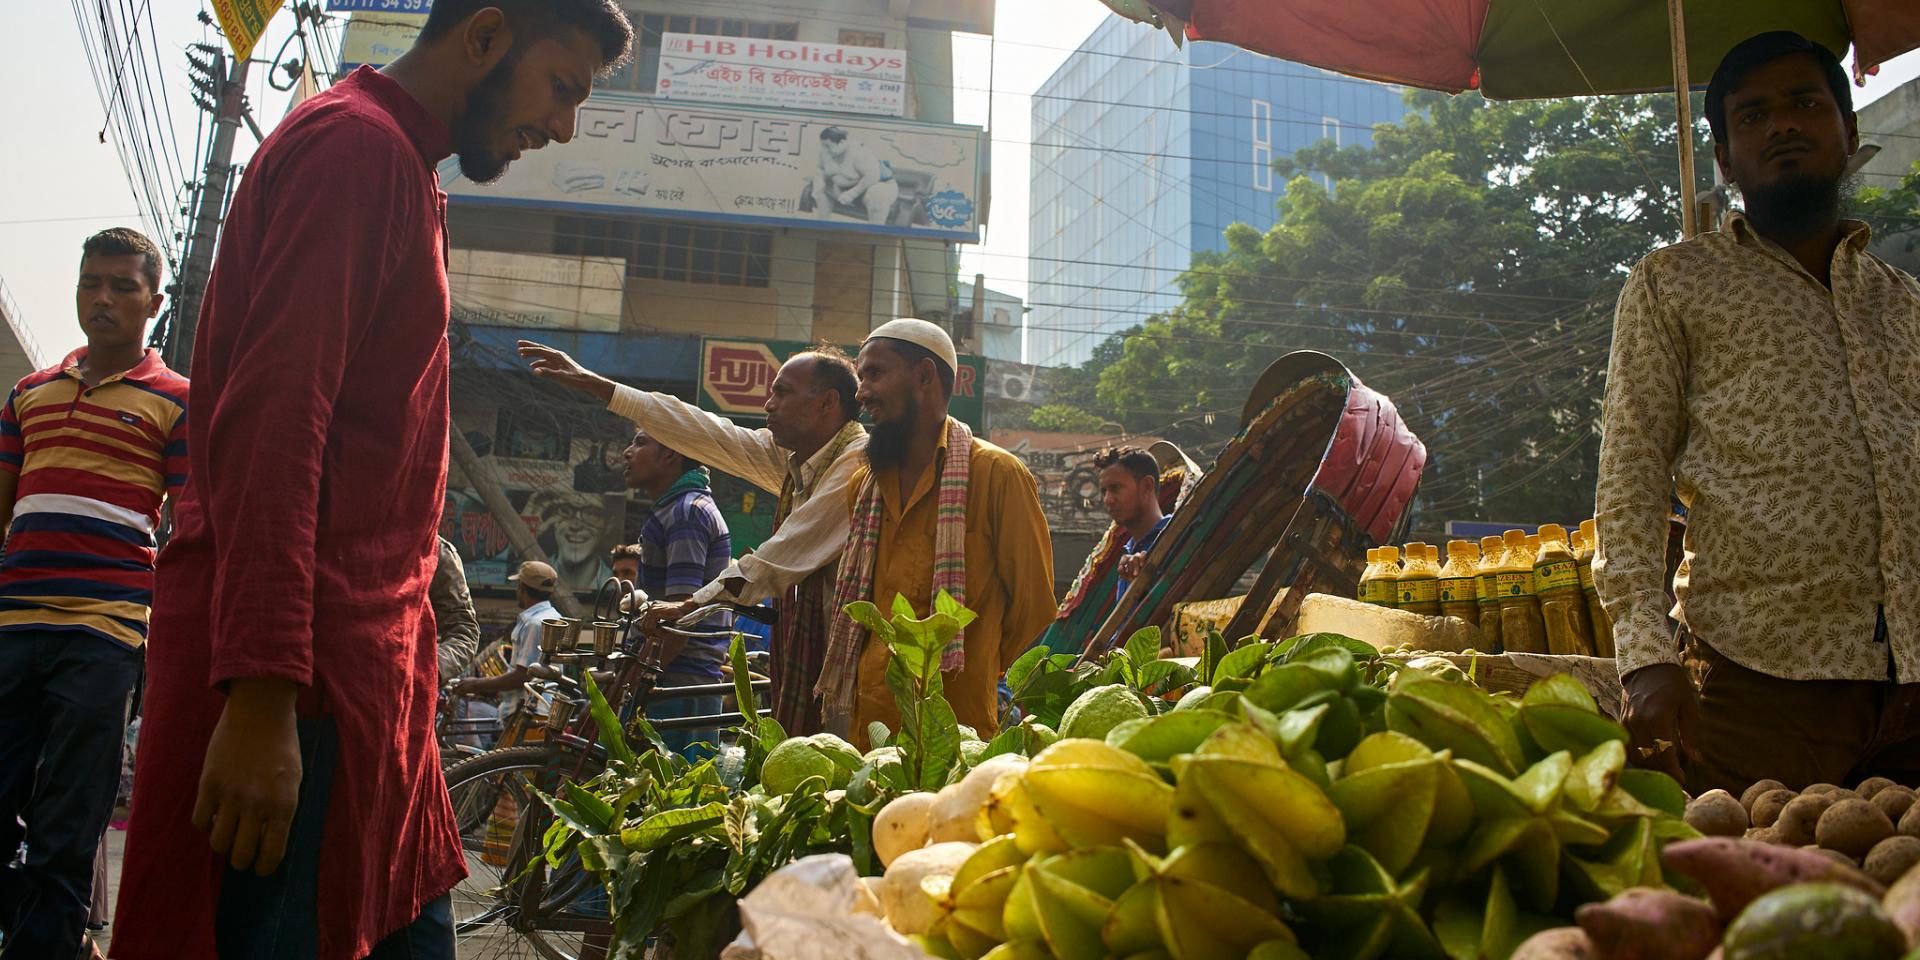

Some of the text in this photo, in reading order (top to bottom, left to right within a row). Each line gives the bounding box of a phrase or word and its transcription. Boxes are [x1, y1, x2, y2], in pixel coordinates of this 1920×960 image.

[686, 39, 903, 72] HB Holidays
[706, 64, 743, 84] এইচ
[748, 67, 766, 85] বি
[771, 68, 848, 91] হলিডেইজ
[654, 110, 807, 156] ফোম
[709, 348, 766, 393] FUJI
